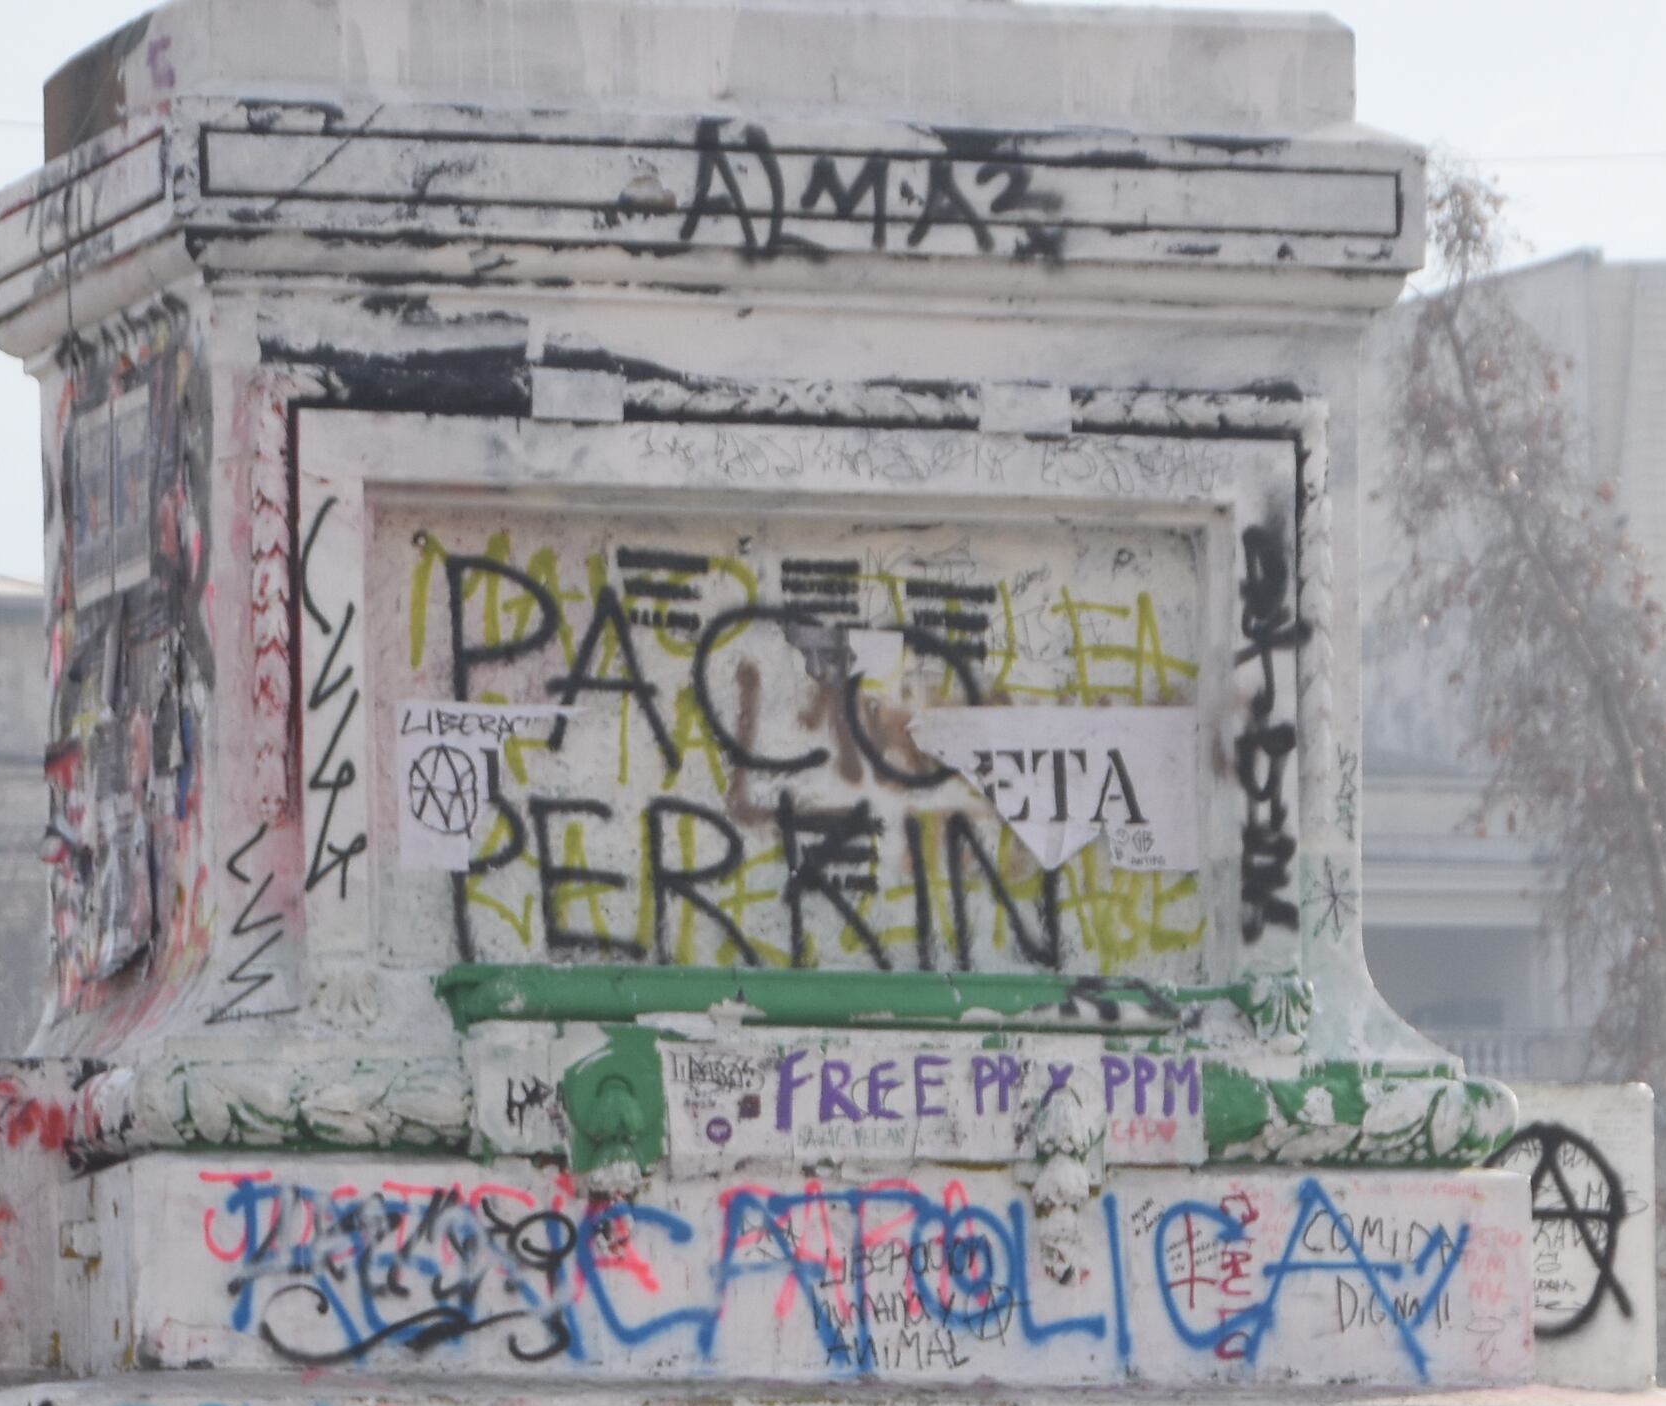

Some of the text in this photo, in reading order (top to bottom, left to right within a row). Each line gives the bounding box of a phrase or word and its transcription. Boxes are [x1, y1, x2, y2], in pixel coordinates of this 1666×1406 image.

[775, 1049, 951, 1133] FREE
[971, 1053, 1021, 1115] PP
[1100, 1054, 1200, 1117] PPM
